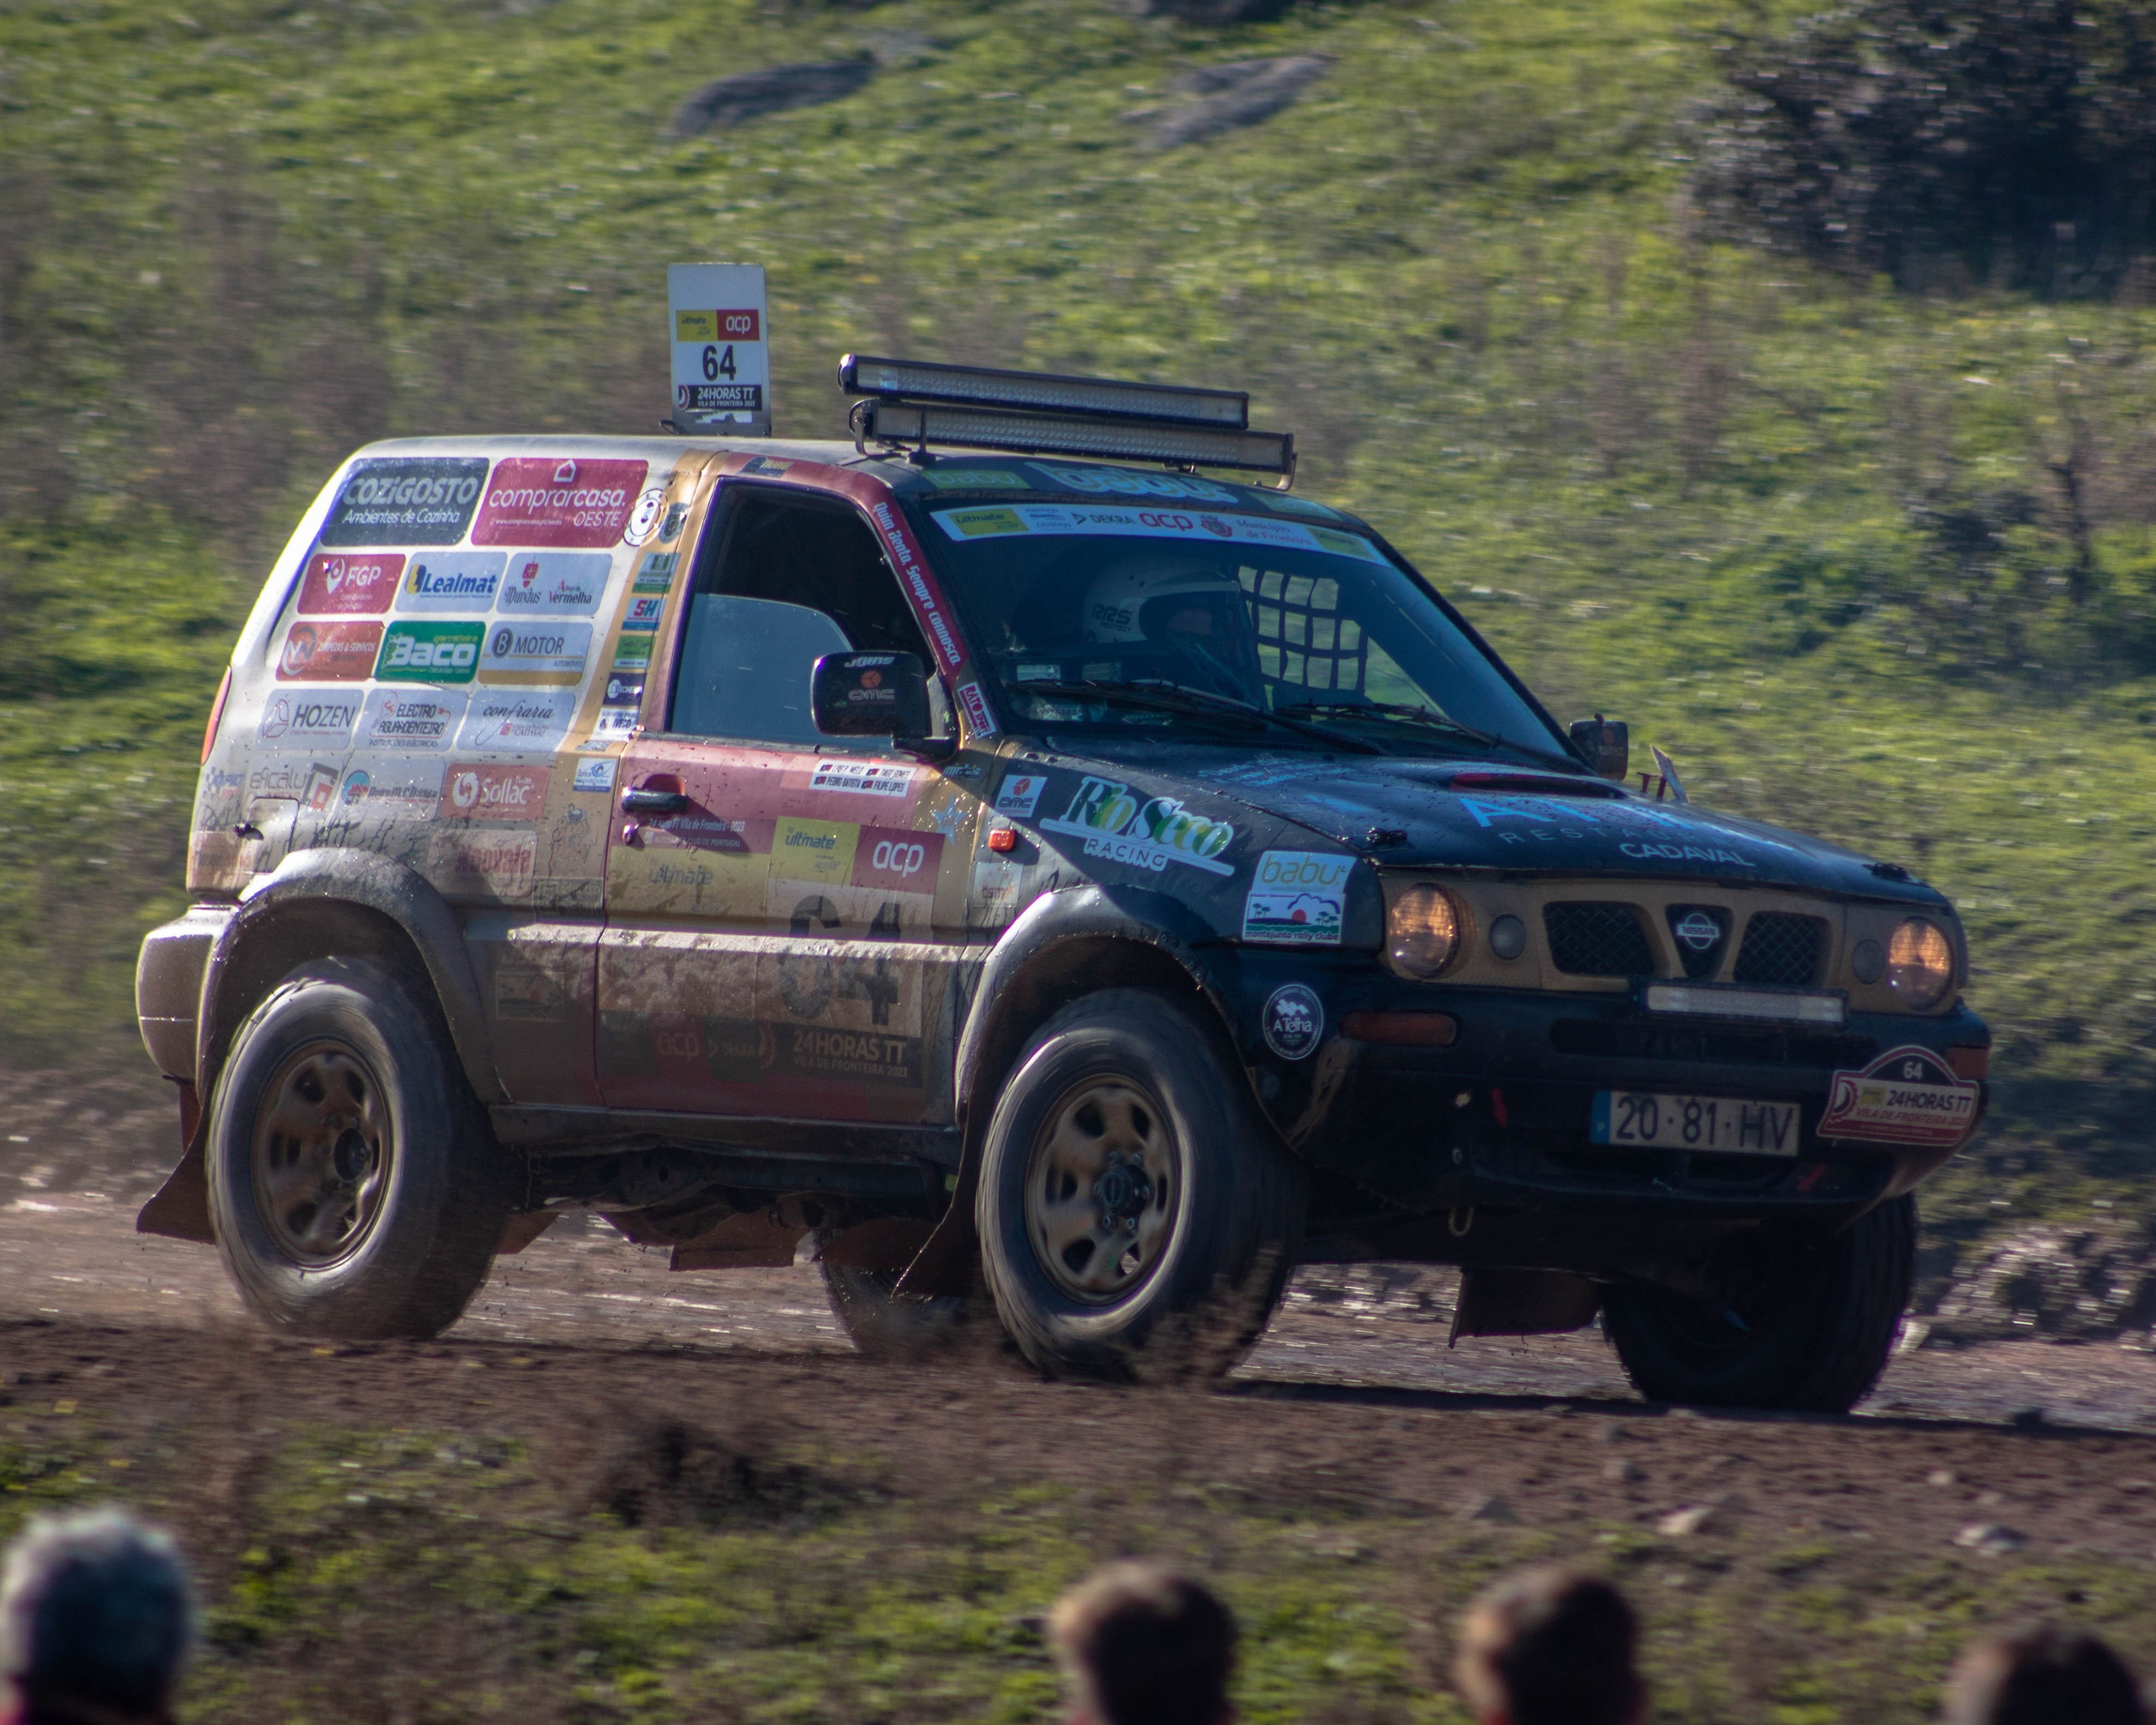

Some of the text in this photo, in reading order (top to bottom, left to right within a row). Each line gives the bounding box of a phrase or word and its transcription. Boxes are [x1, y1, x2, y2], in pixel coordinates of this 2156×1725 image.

[725, 316, 751, 334] acp
[702, 344, 737, 382] 64
[743, 387, 755, 400] TT
[342, 508, 461, 524] Ambientes de Cozinha
[573, 511, 622, 526] OESTE
[1089, 514, 1135, 525] DEKRA
[1139, 512, 1193, 531] acp
[345, 566, 382, 587] FGP
[424, 573, 498, 594] Lealmat
[549, 590, 592, 605] Vermelha
[633, 600, 659, 617] SH
[390, 636, 477, 666] Baco
[514, 636, 564, 654] MOTOR
[964, 686, 983, 712] RATO
[292, 704, 355, 728] HOZEN
[397, 703, 436, 718] ELECTRO
[612, 718, 632, 729] IVECO
[479, 777, 531, 805] Sollac
[680, 818, 691, 829] Vila
[692, 819, 699, 830] de
[700, 820, 726, 831] Fronteira
[730, 820, 745, 832] 2023
[785, 831, 835, 850] ultimate
[873, 841, 924, 878] acp
[1087, 838, 1166, 867] RACING
[1620, 843, 1756, 868] CADAVAL
[1262, 854, 1341, 885] babu
[1315, 930, 1338, 941] clube
[1683, 927, 1716, 936] NISSAN
[1273, 1017, 1312, 1033] A Telha
[657, 1031, 700, 1061] acp
[883, 1040, 907, 1064] TT
[792, 1055, 909, 1078] VILA DE FRONTEIRA 2023
[1903, 1061, 1924, 1080] 64
[1956, 1097, 1972, 1113] TT
